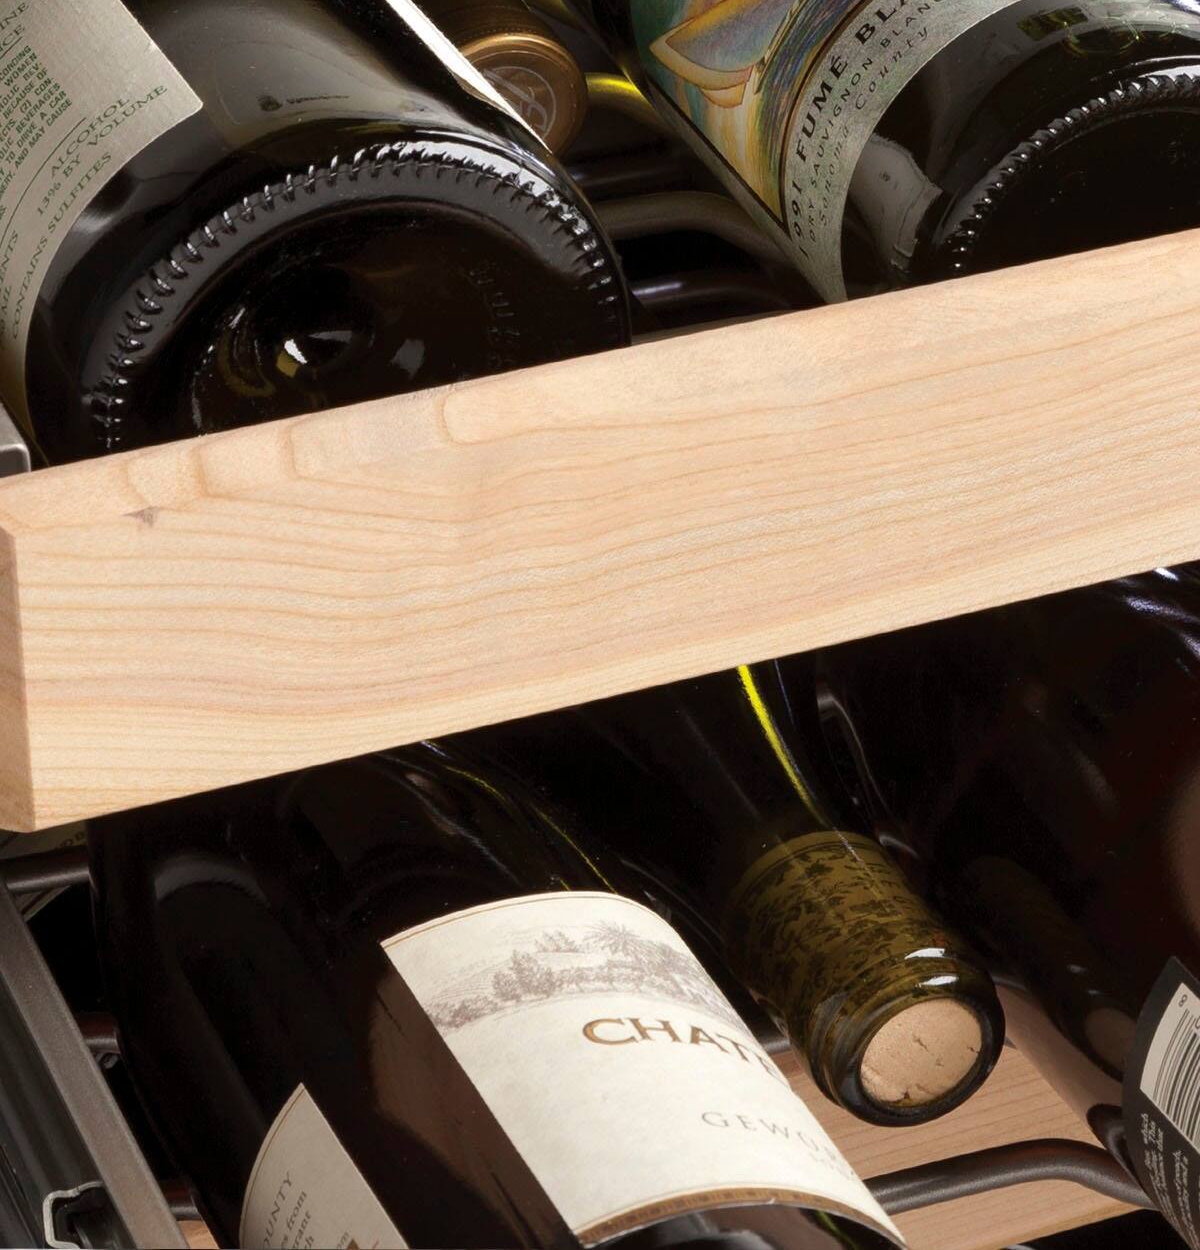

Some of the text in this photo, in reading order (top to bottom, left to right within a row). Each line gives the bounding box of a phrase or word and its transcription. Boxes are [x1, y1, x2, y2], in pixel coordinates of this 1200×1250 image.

[3, 52, 38, 88] WOMEN
[36, 68, 49, 81] OF
[855, 26, 929, 111] County
[5, 151, 17, 166] TO
[16, 120, 38, 150] DRIVE
[39, 111, 49, 121] A
[48, 90, 67, 111] CAR
[13, 148, 30, 170] AND
[28, 126, 47, 150] MAY
[46, 98, 73, 128] CAUSE
[15, 82, 62, 134] BEVERAGES
[51, 97, 131, 177] ALCOHOL
[63, 154, 83, 178] BY
[87, 84, 169, 147] VOLUME
[796, 54, 849, 163] FUMÉ
[810, 57, 874, 189] SAUVIGNON
[13, 153, 114, 340] CONTAINS SULFITES
[581, 1015, 791, 1087] CHATE
[285, 1190, 309, 1232] from
